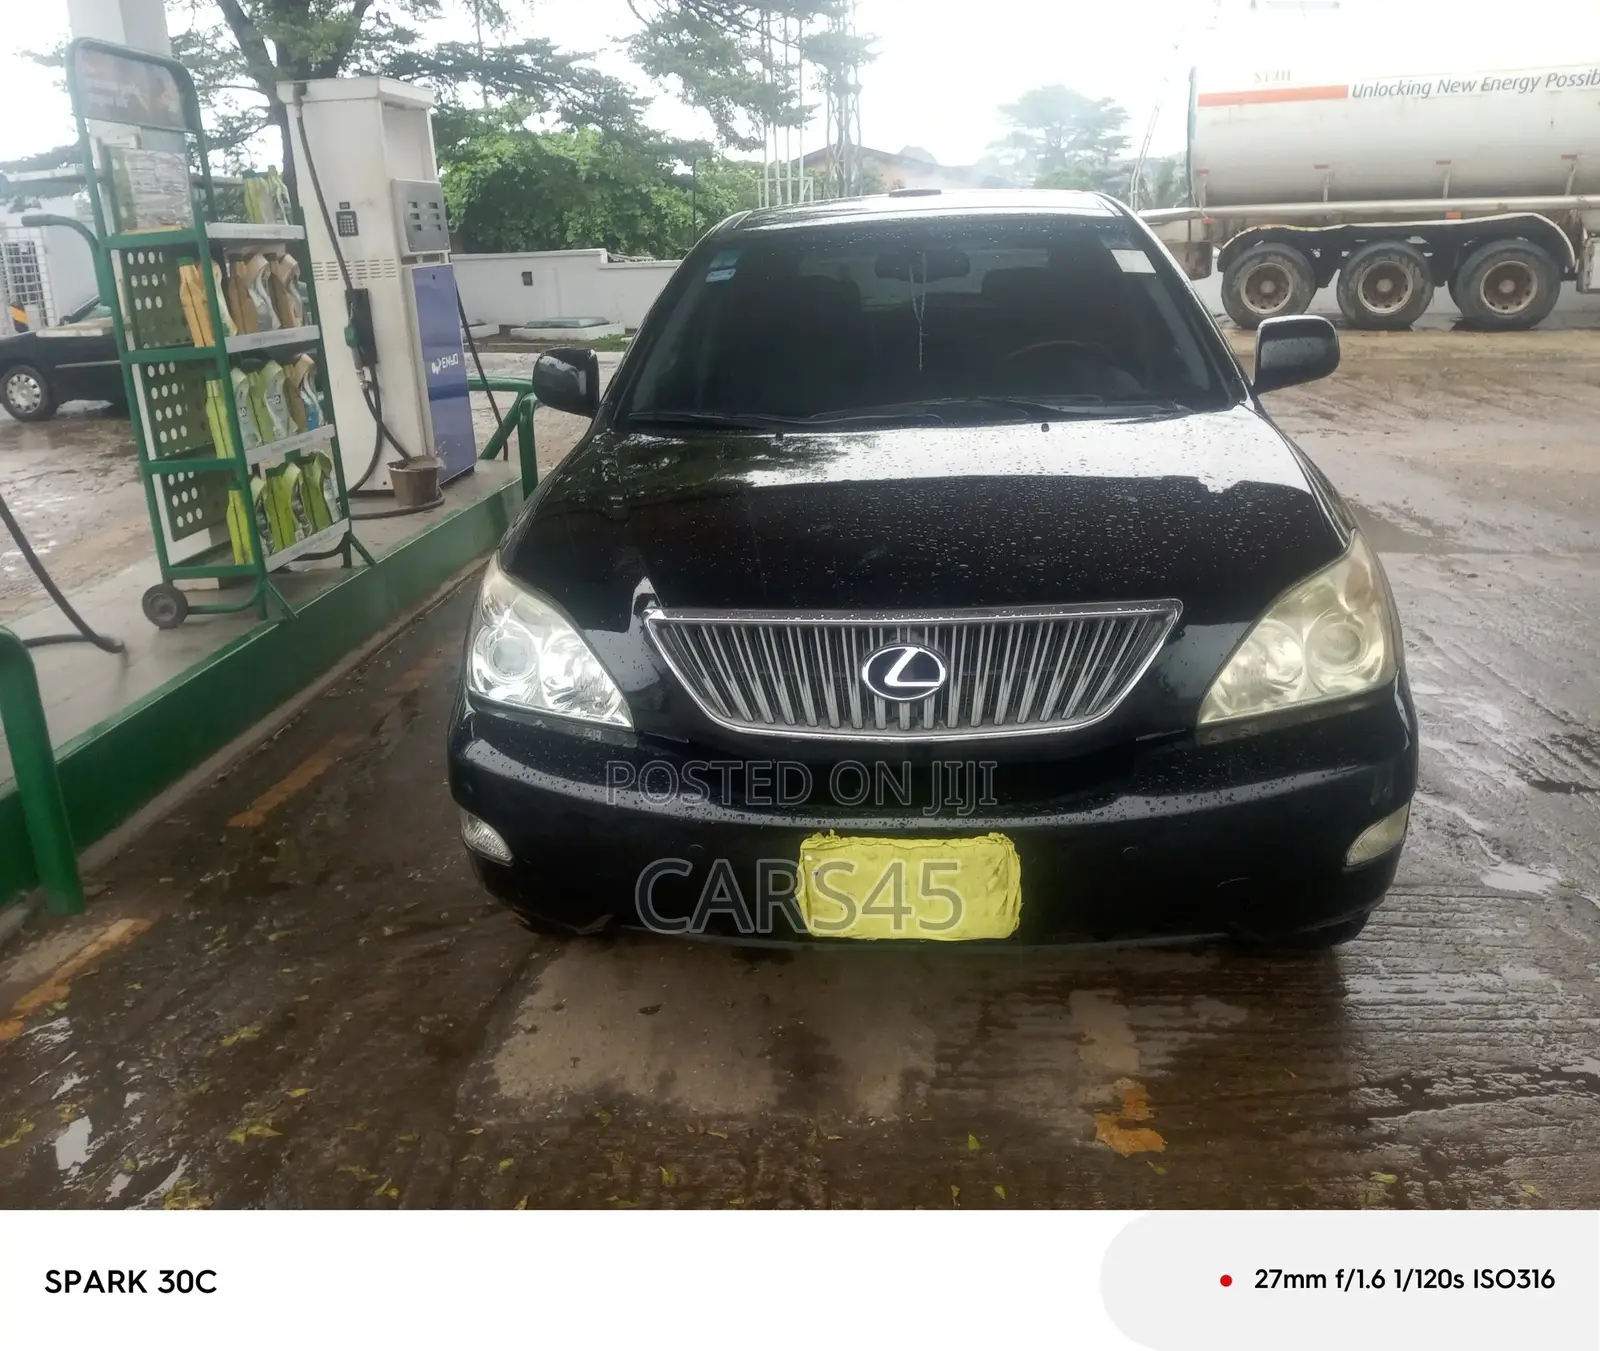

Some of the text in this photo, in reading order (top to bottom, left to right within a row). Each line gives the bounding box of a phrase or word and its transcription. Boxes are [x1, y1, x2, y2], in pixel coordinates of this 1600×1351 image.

[1352, 68, 1600, 99] Unlocking New Energy Possib
